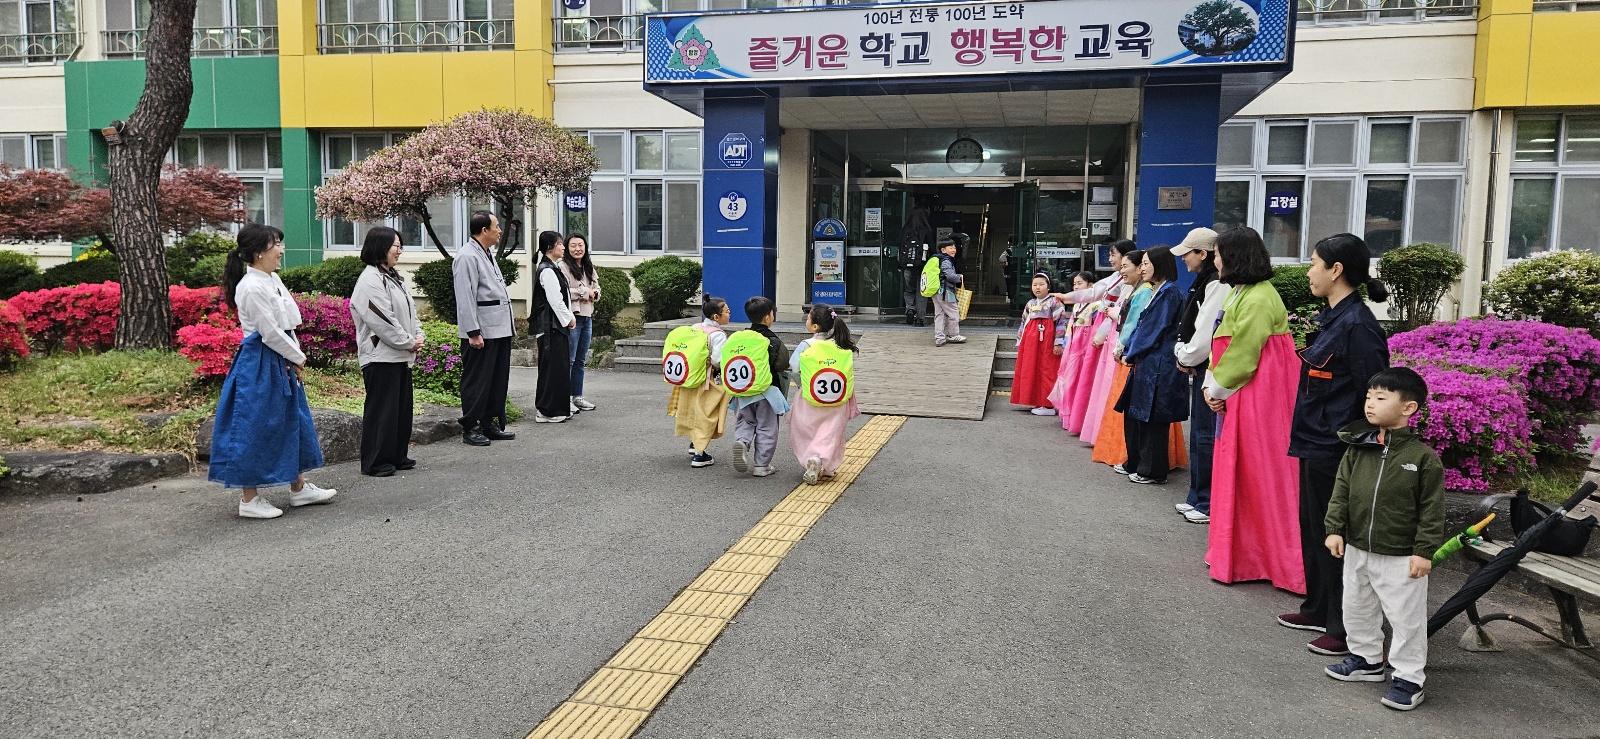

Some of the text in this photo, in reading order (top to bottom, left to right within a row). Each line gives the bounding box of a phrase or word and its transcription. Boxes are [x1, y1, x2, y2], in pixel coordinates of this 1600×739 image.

[864, 3, 1025, 25] 100년 전통 100년 도약
[748, 20, 1153, 71] 즐거운 학교 행복한 교육
[724, 144, 747, 158] ADT
[727, 202, 739, 211] 43
[1269, 196, 1299, 209] 교장실
[666, 360, 683, 376] 30
[728, 364, 749, 383] 30
[816, 378, 842, 395] 30
